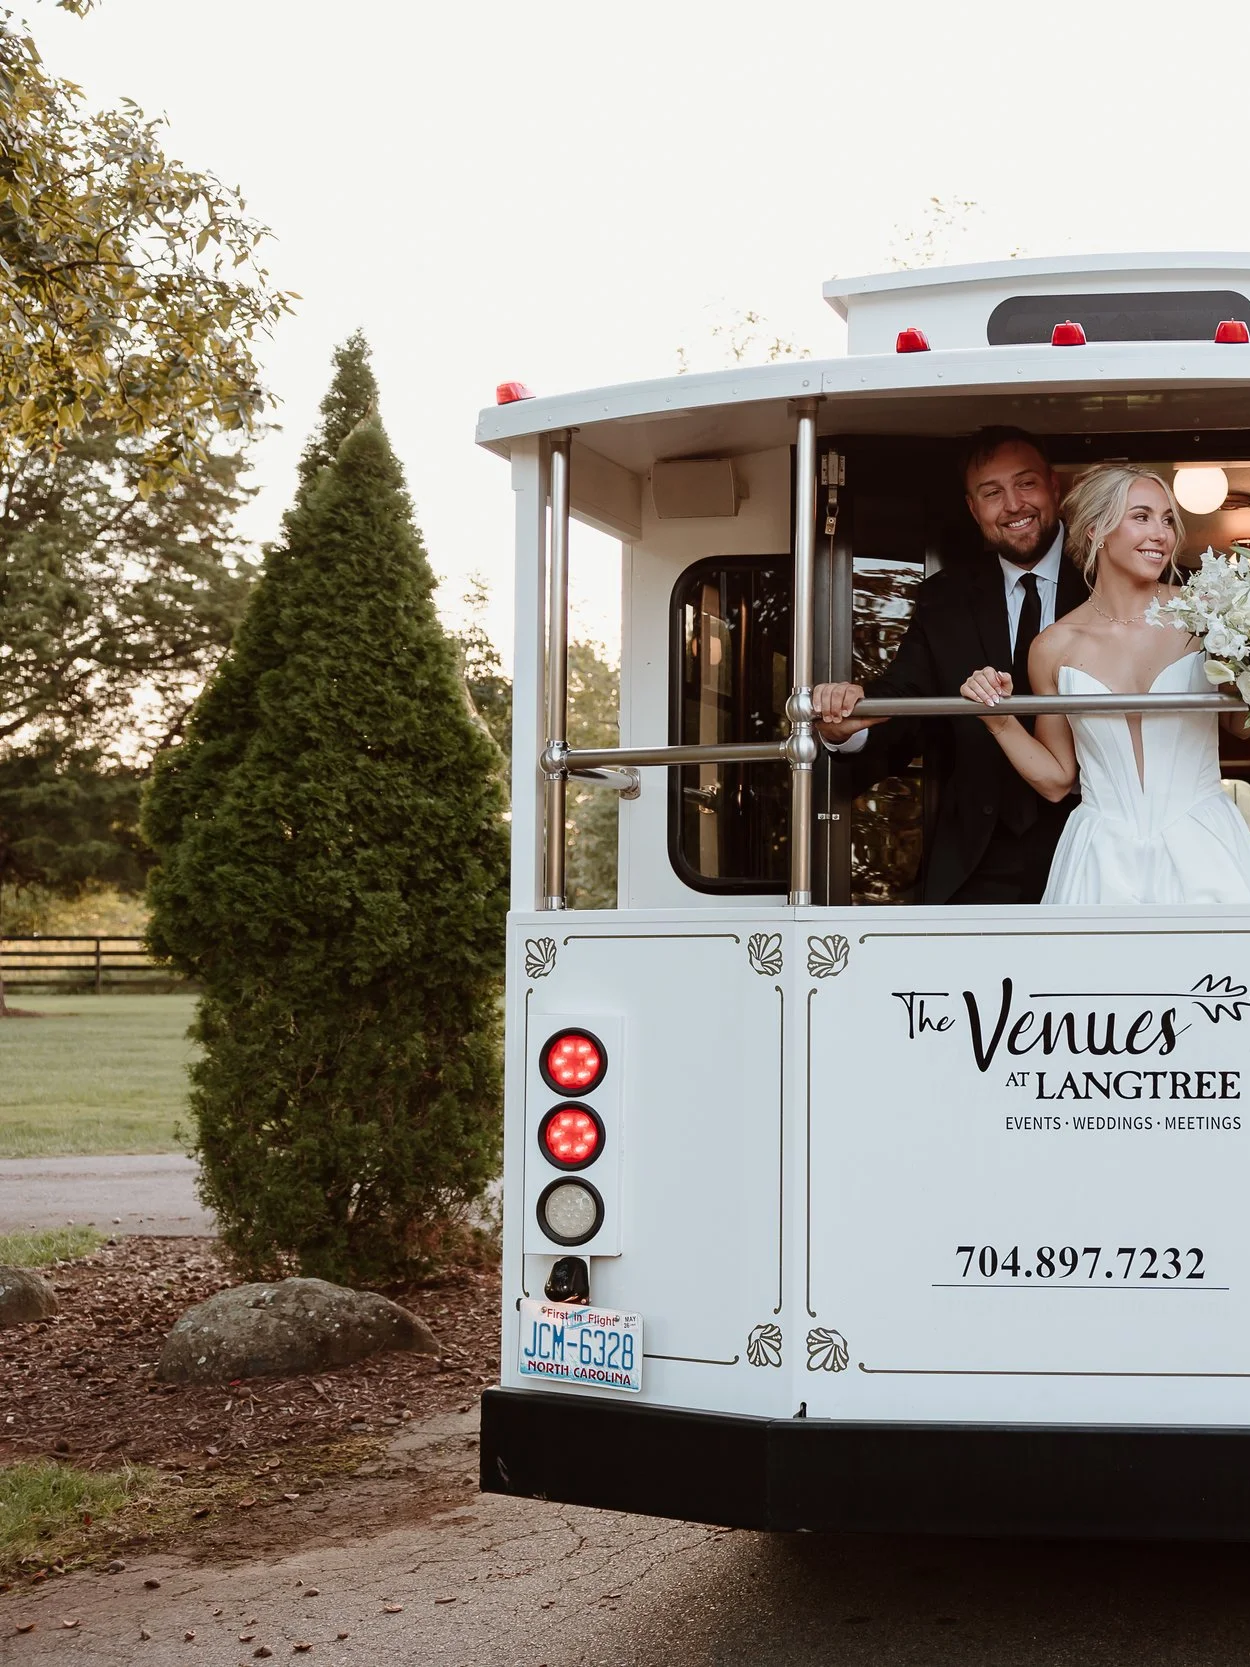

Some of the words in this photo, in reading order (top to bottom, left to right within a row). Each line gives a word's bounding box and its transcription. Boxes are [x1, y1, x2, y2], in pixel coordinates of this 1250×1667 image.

[891, 991, 956, 1039] The
[962, 977, 1192, 1072] Venues
[1005, 1072, 1030, 1087] AT
[1035, 1070, 1241, 1100] LANGTREE
[1005, 1116, 1061, 1130] EVENTS
[1073, 1116, 1153, 1130] WEDDINGS
[1165, 1116, 1242, 1130] MEETINGS
[955, 1245, 1206, 1280] 704.897.7232
[546, 1308, 569, 1321] First
[574, 1312, 582, 1322] in
[588, 1314, 616, 1328] Flight
[524, 1321, 633, 1370] JCM-6328
[528, 1360, 569, 1376] NORTH
[573, 1367, 631, 1385] CAROLINA
